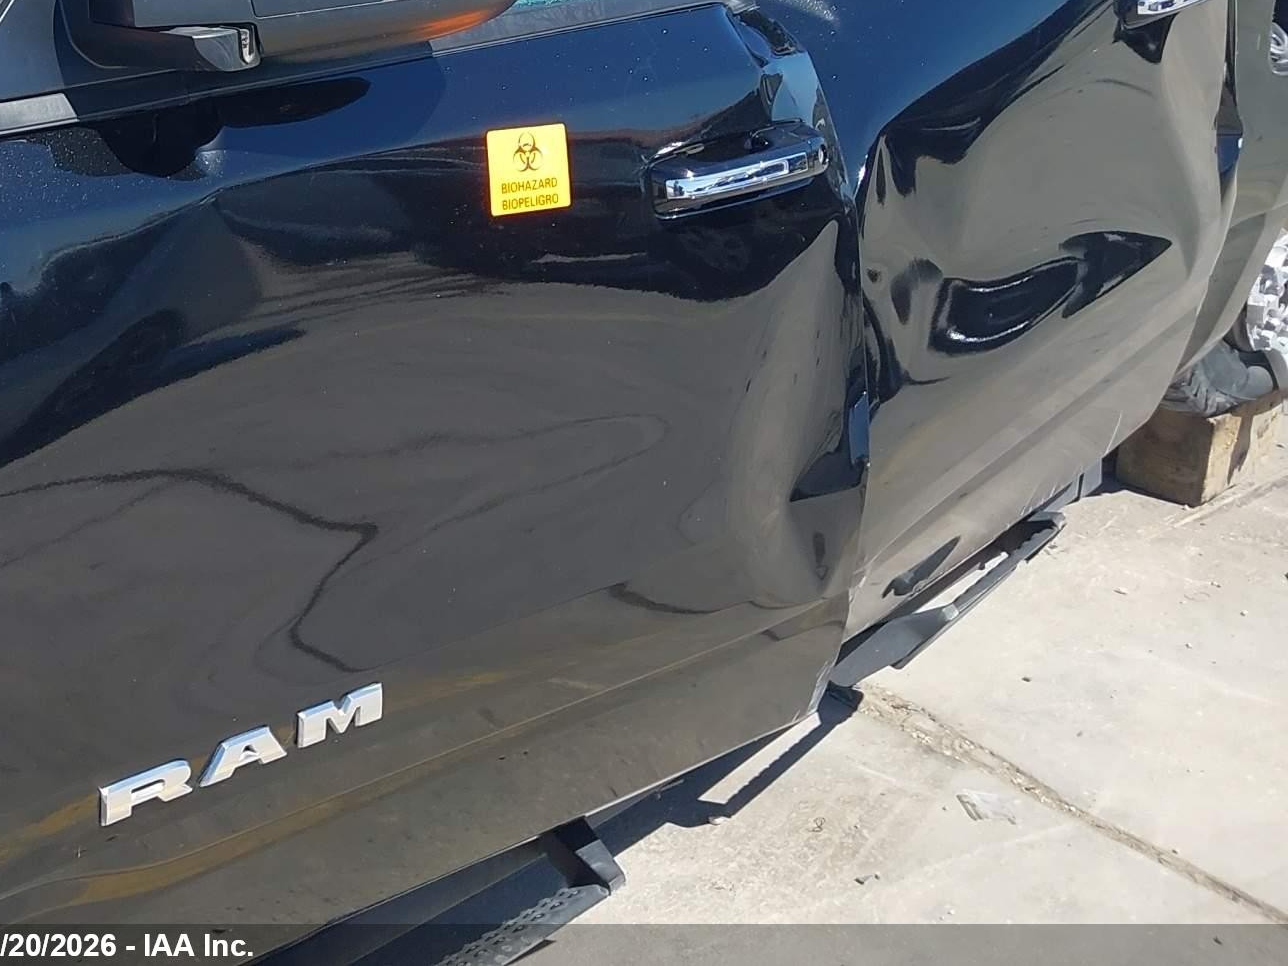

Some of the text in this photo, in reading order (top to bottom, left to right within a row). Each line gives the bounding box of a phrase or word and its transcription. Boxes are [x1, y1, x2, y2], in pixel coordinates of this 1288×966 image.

[501, 177, 558, 194] BIOHAZARD
[502, 193, 559, 211] BIOPELIGRO
[99, 682, 383, 827] RAM
